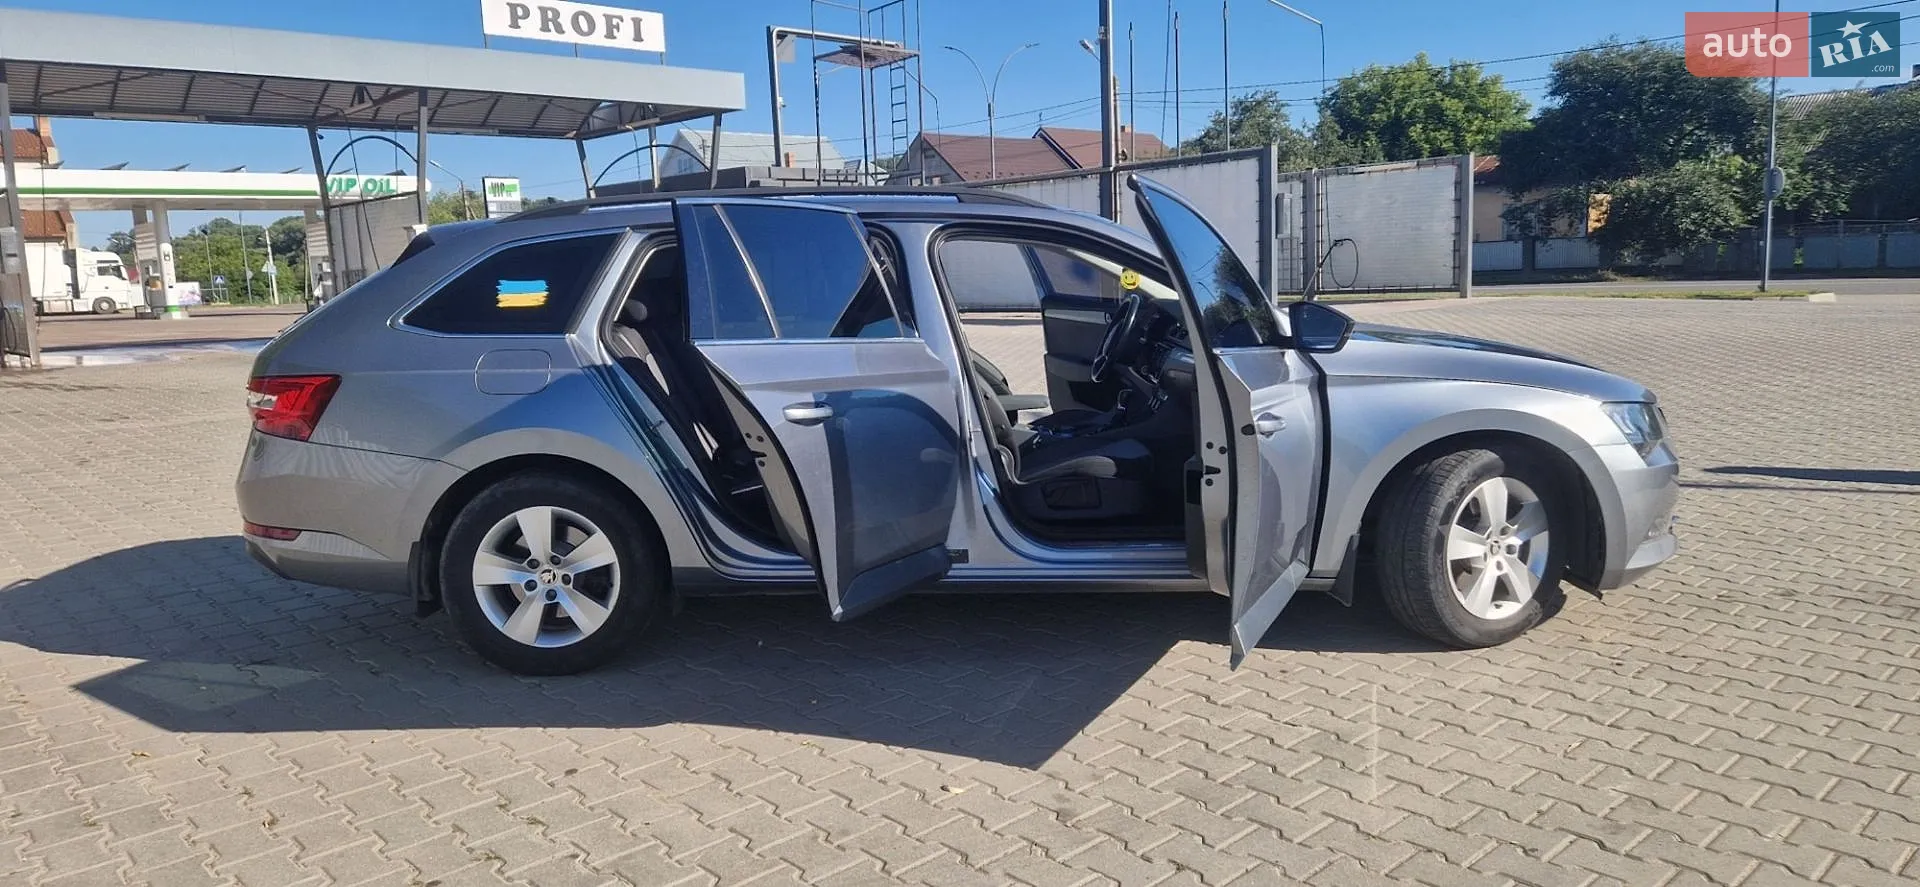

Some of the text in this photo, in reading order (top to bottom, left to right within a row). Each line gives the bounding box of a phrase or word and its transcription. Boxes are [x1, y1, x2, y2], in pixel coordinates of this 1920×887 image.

[506, 2, 645, 43] PROFI
[327, 177, 357, 193] VIP
[490, 181, 505, 198] VIP
